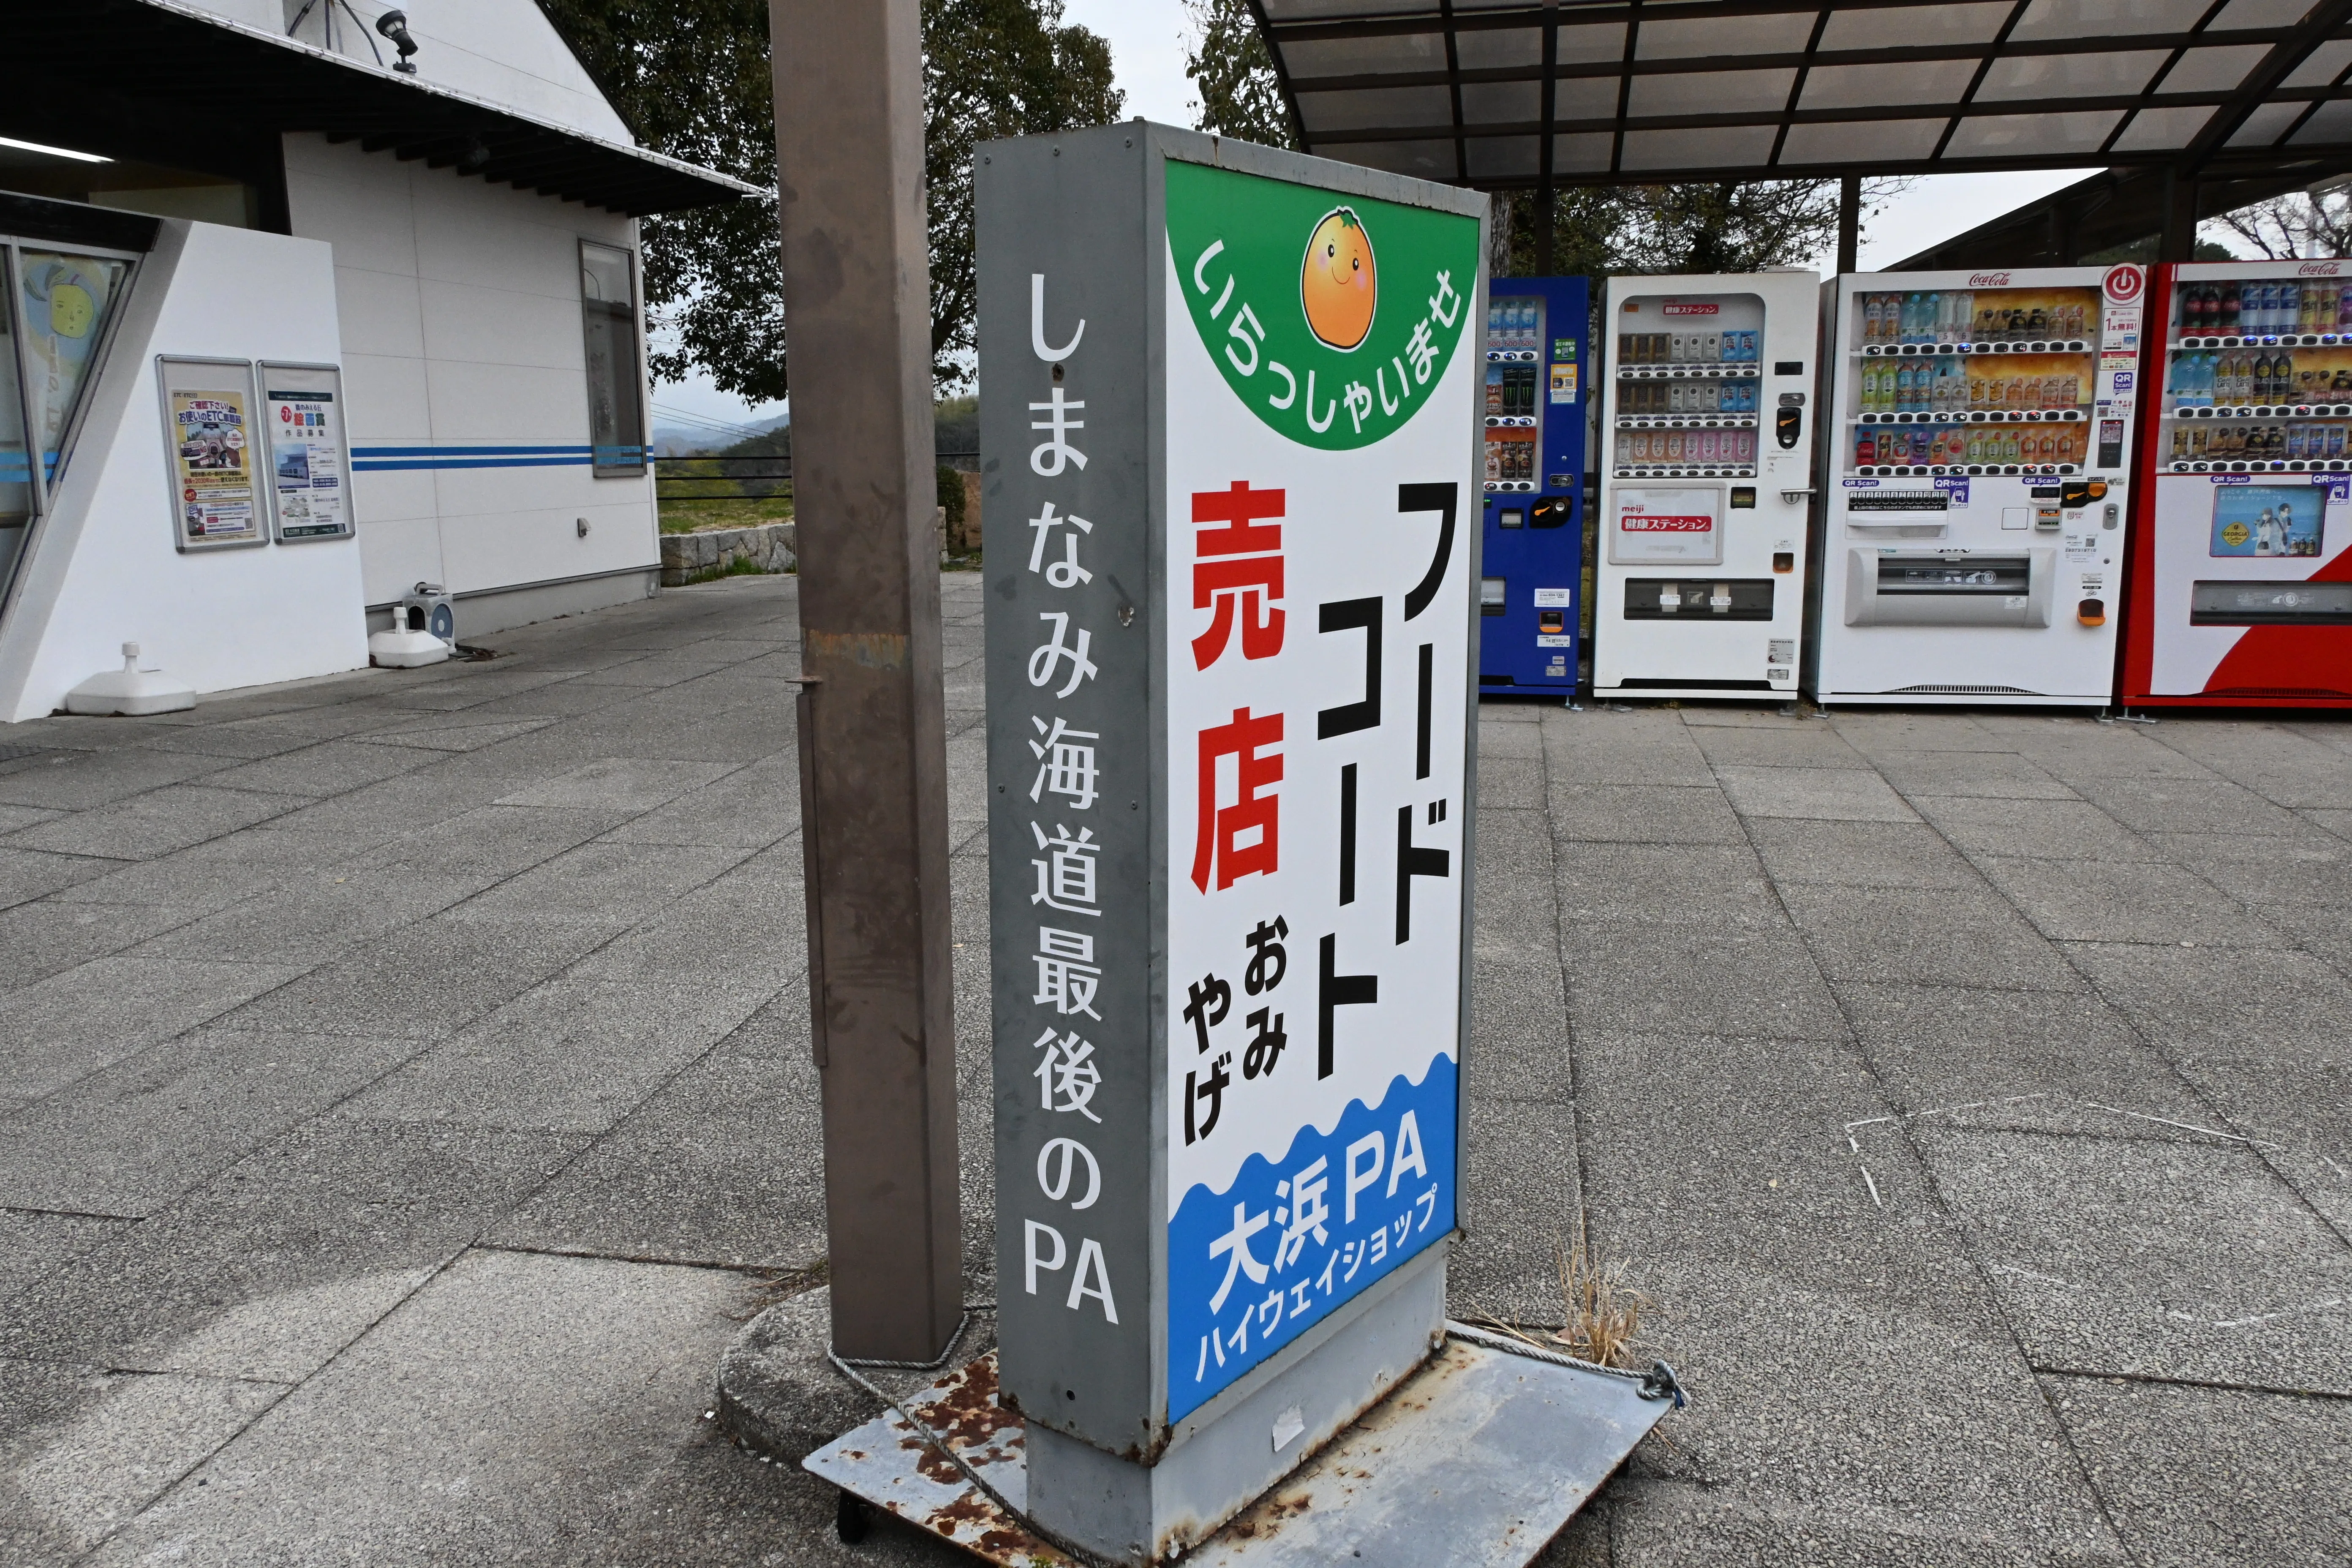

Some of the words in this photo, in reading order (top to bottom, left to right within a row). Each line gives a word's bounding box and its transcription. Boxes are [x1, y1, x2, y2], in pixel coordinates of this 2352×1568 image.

[2299, 262, 2341, 275] Coca-Cola
[1969, 272, 2012, 286] Coca-Cola
[1665, 306, 1716, 314] 健康ステーション
[1192, 239, 1462, 434] いらっしゃいませ
[2115, 374, 2131, 383] QR
[1935, 479, 1950, 487] QR
[2313, 475, 2329, 483] QR
[1622, 505, 1644, 514] meiji
[1625, 519, 1707, 530] 健康ステーション
[1192, 481, 1285, 893] 売店
[1396, 482, 1458, 946] フード
[1318, 596, 1383, 1081] コート
[1243, 915, 1289, 1080] おみ
[1183, 973, 1232, 1146] やげ
[1195, 1182, 1437, 1383] ハイウェイショップ
